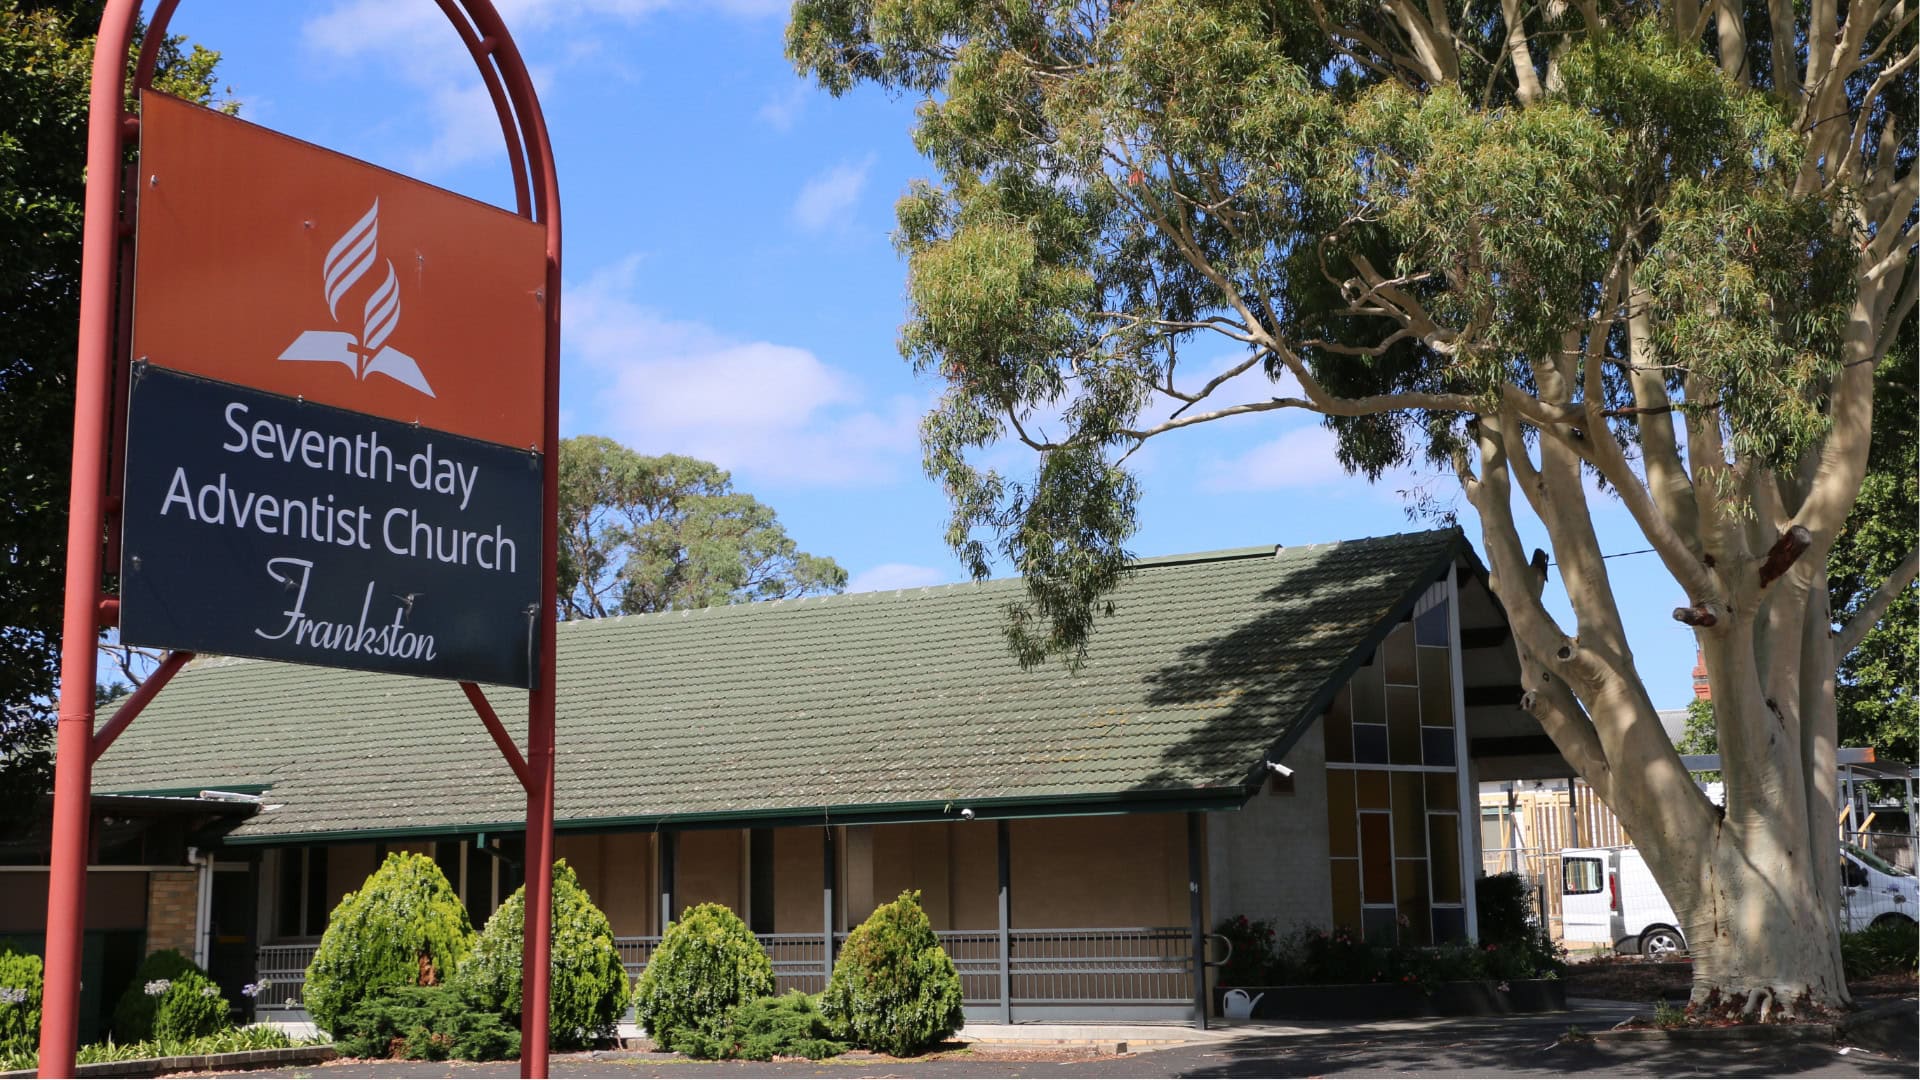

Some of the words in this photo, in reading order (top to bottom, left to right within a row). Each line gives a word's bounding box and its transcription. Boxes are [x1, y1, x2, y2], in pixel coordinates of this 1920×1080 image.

[222, 402, 478, 511] Seventh-day
[160, 467, 371, 549] Adventist
[383, 507, 516, 573] Church
[255, 557, 437, 662] Frankston
